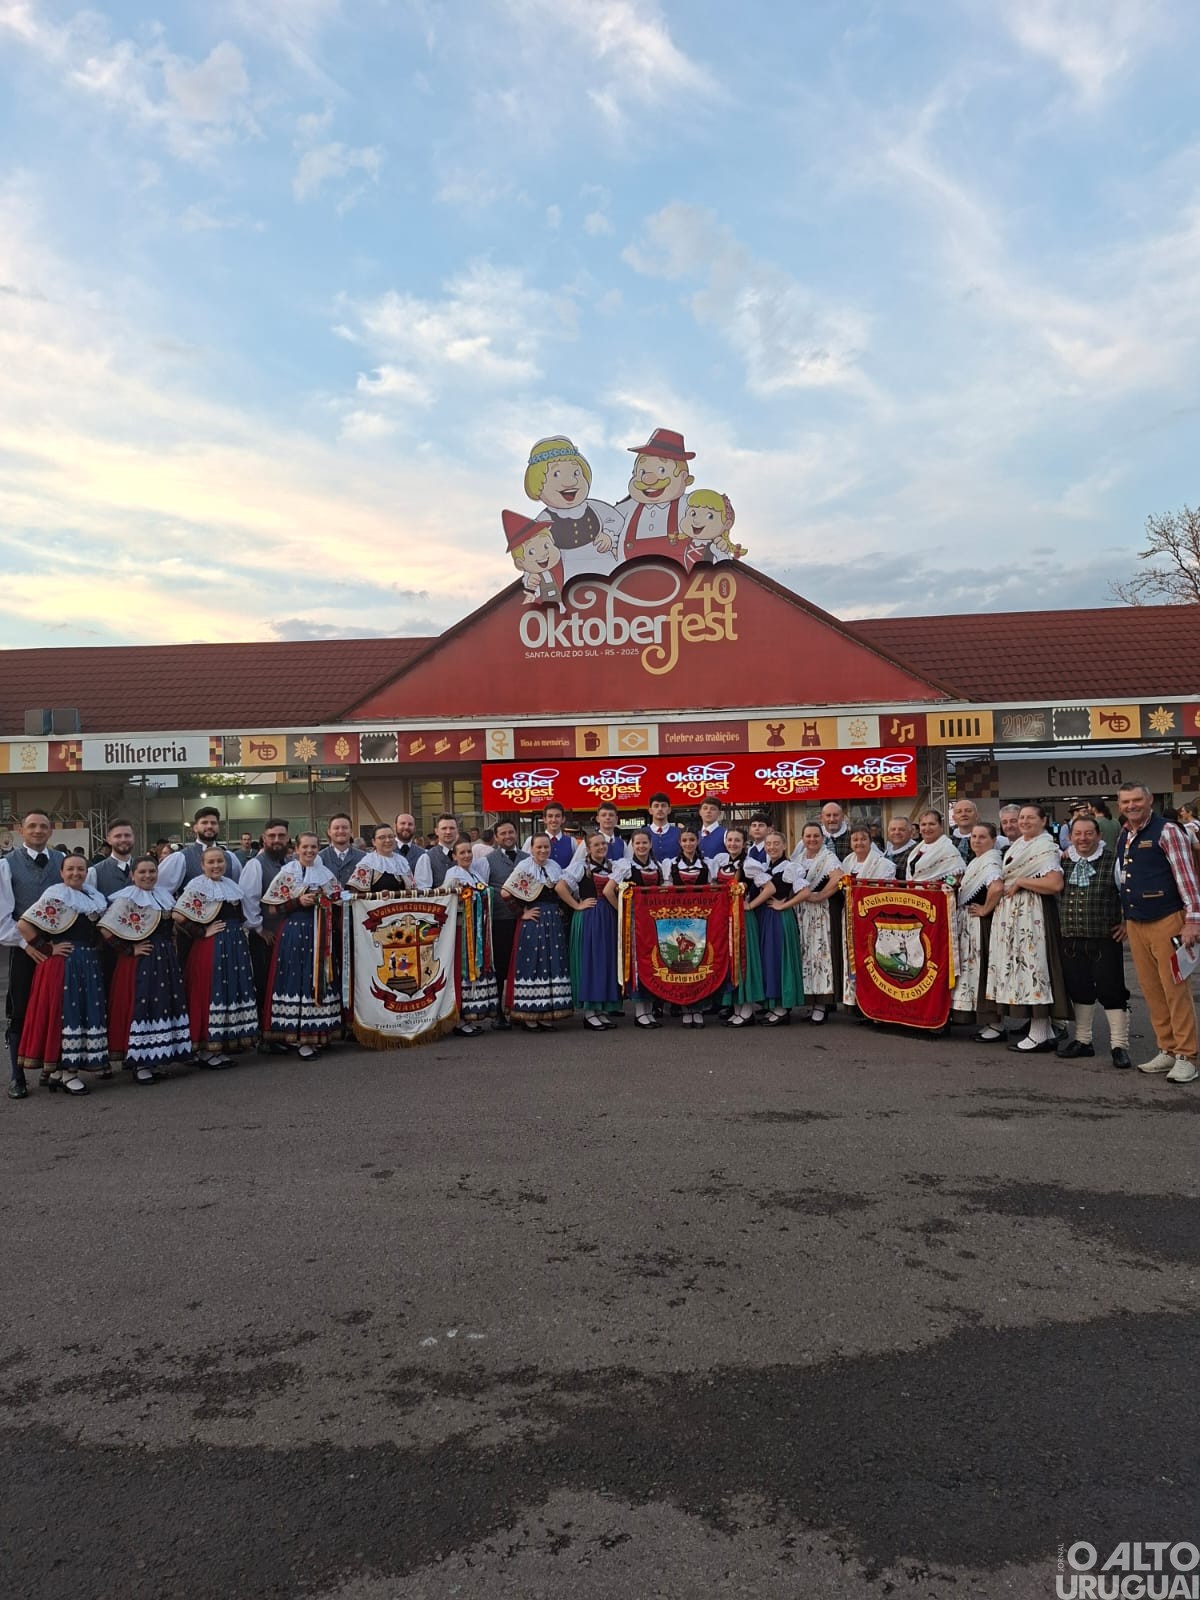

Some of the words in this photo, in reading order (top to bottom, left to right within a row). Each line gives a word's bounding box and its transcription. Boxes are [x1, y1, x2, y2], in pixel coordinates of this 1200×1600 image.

[684, 572, 737, 612] 40
[524, 651, 549, 659] SANTA
[550, 650, 571, 658] CRUZ
[584, 649, 599, 657] SUL
[621, 648, 640, 656] 2025
[1002, 713, 1046, 738] 2025
[664, 732, 694, 744] Celebre
[694, 733, 705, 743] as
[705, 731, 740, 744] tradições
[104, 741, 188, 764] Bilheteria
[578, 764, 647, 786] Oktober
[666, 761, 735, 783] Oktober
[754, 757, 826, 779] Oktober
[841, 753, 914, 776] Oktober
[1047, 763, 1123, 787] Entrada
[492, 768, 560, 789] Oktober
[674, 781, 698, 793] 40
[688, 780, 730, 798] fest
[763, 778, 787, 789] 40
[777, 776, 820, 794] fest
[850, 774, 874, 786] 40
[864, 773, 908, 791] fest
[500, 788, 523, 799] 40
[513, 787, 555, 804] fest
[586, 785, 610, 796] 40
[600, 783, 642, 801] fest
